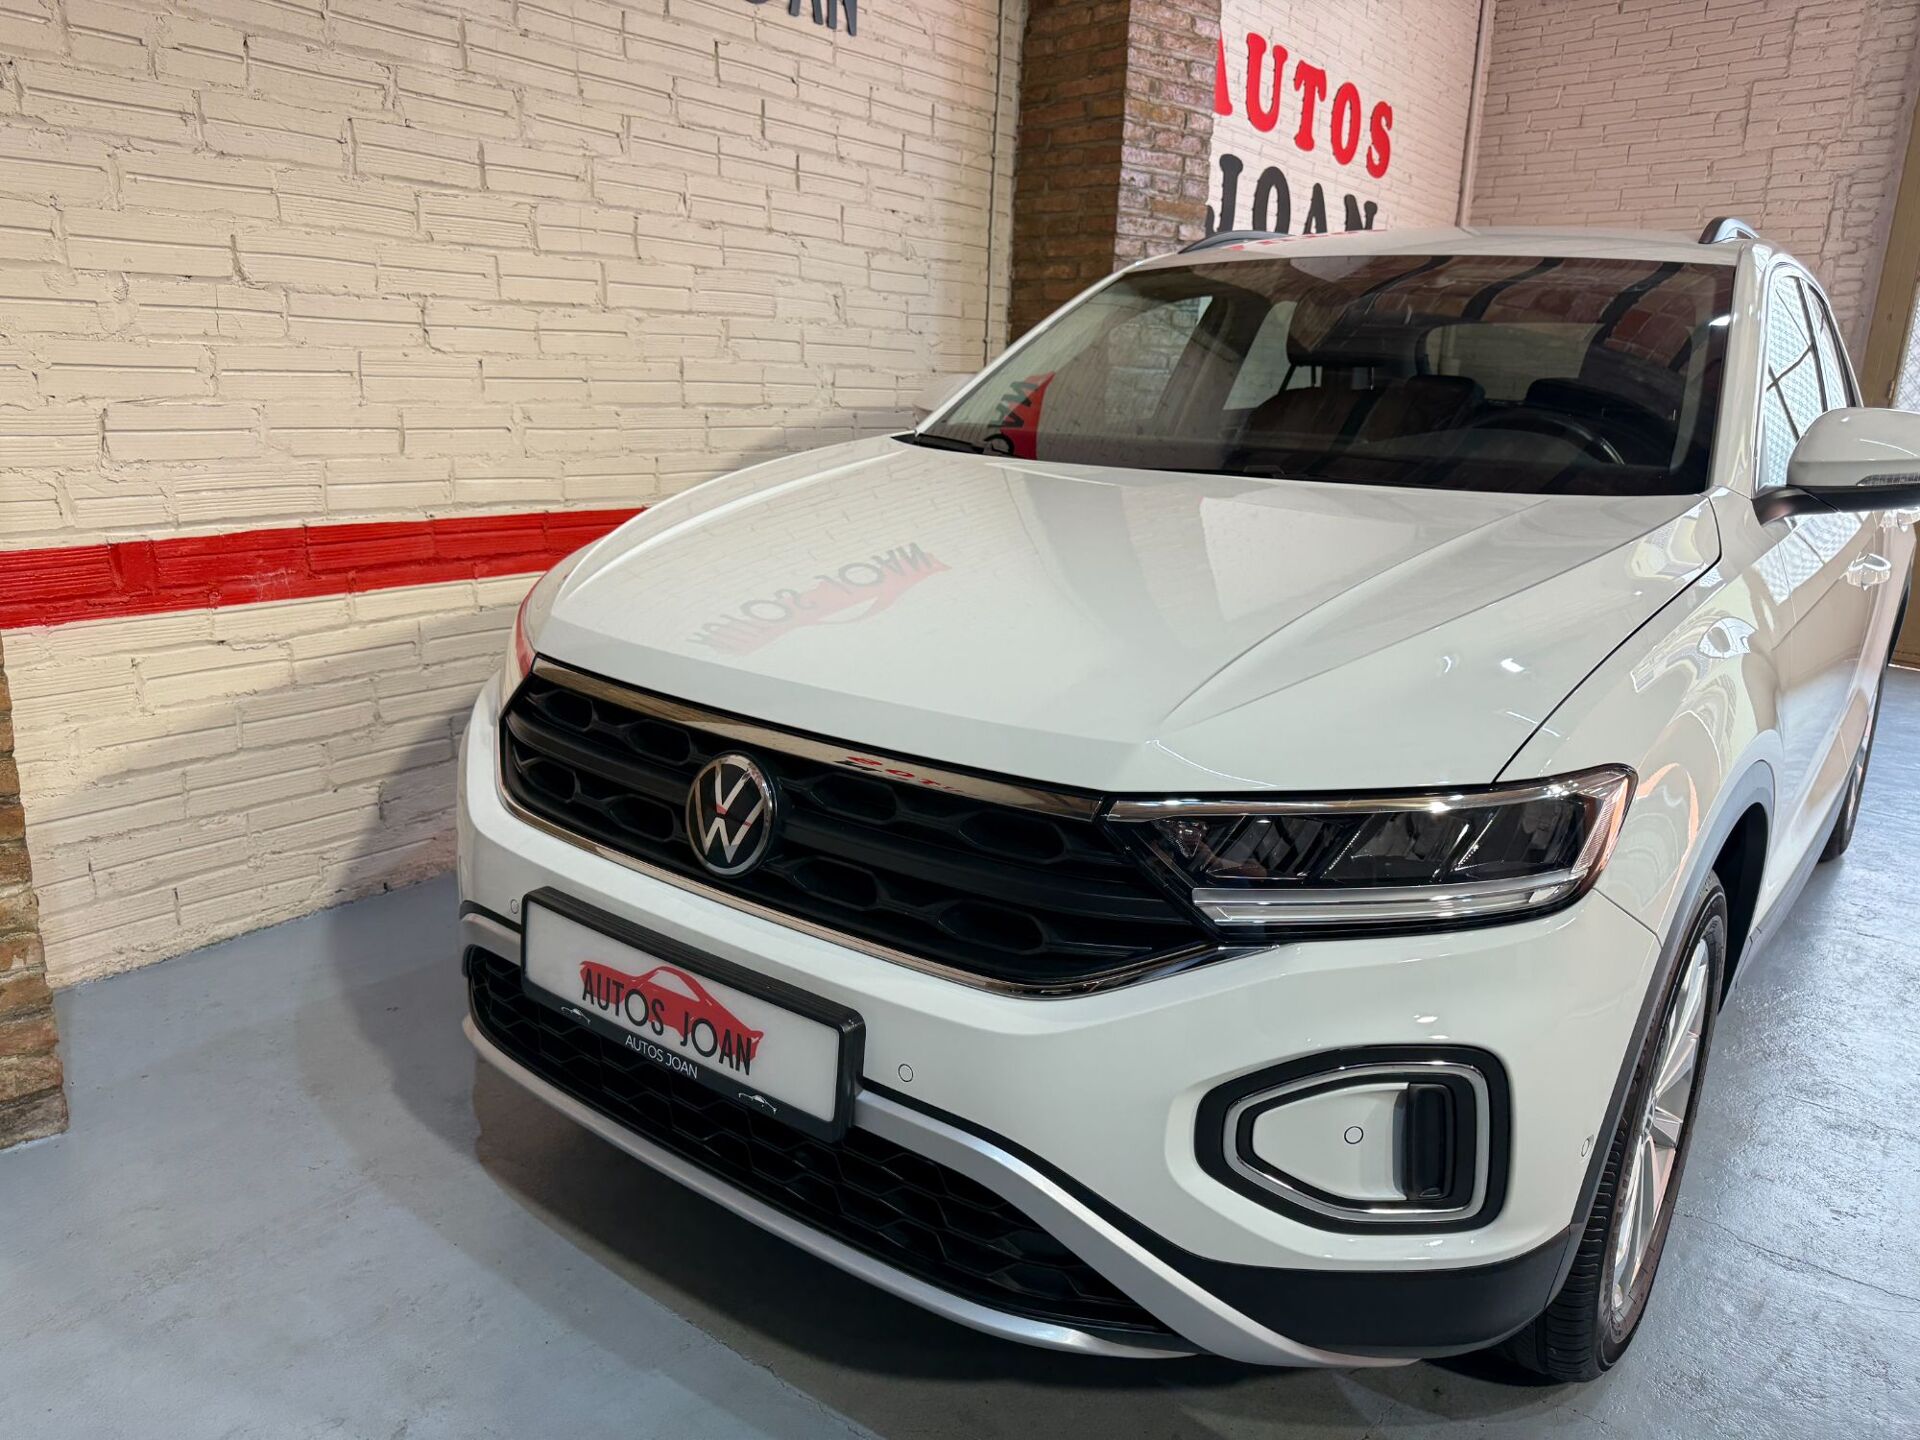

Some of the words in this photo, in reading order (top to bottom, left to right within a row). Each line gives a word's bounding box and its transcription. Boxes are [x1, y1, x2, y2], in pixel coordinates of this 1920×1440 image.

[582, 967, 665, 1036] AUTOS
[679, 1010, 752, 1076] JOAN
[625, 1034, 664, 1062] AUTOS
[665, 1053, 699, 1079] JOAN
